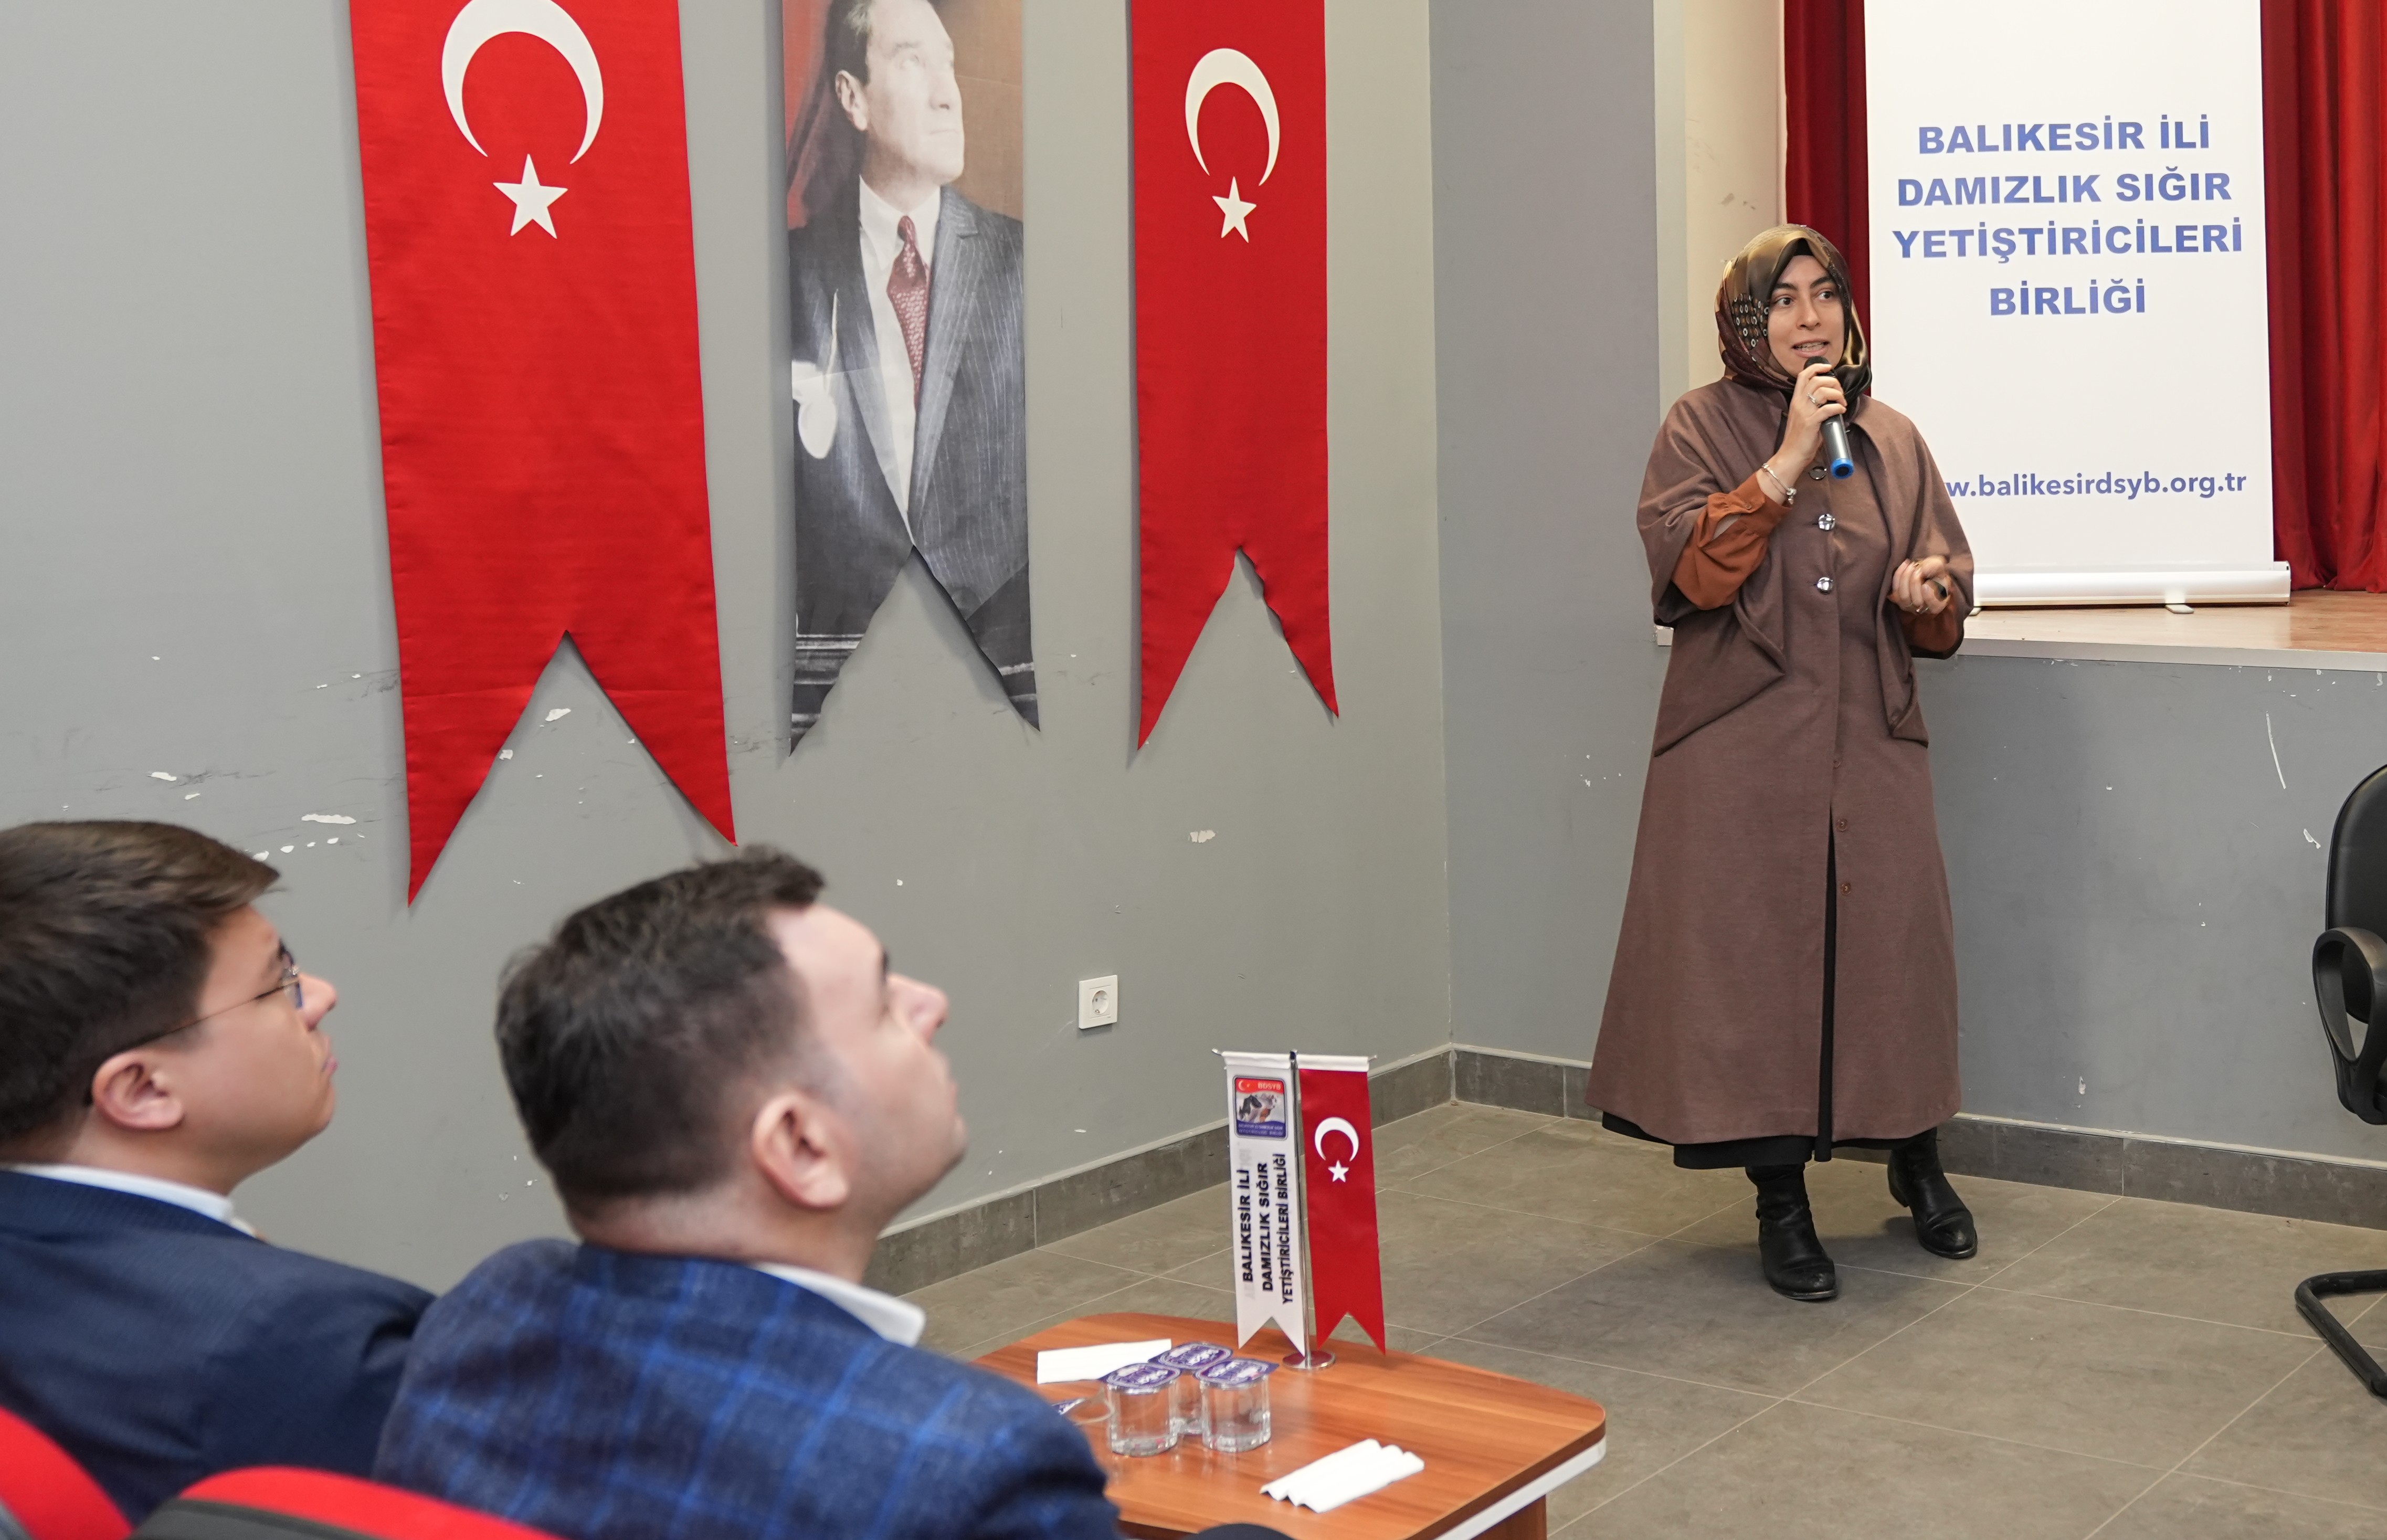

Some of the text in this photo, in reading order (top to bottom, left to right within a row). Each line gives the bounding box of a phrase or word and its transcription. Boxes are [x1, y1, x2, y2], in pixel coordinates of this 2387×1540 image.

[1919, 114, 2209, 154] BALIKESİR İLİ
[1898, 166, 2232, 207] DAMIZLIK SIĞIR
[1893, 217, 2242, 263] YETİŞTİRİCİLERİ
[1990, 278, 2145, 316] BİRLİĞİ
[1944, 471, 2247, 500] w.balikesirdsyb.org.tr
[1237, 1169, 1253, 1282] BALIKESİR İLİ
[1256, 1163, 1273, 1292] DAMIZLIK SIĞIR
[1273, 1154, 1294, 1305] YETİŞTİRİCİLERİ BİRLİĞİ
